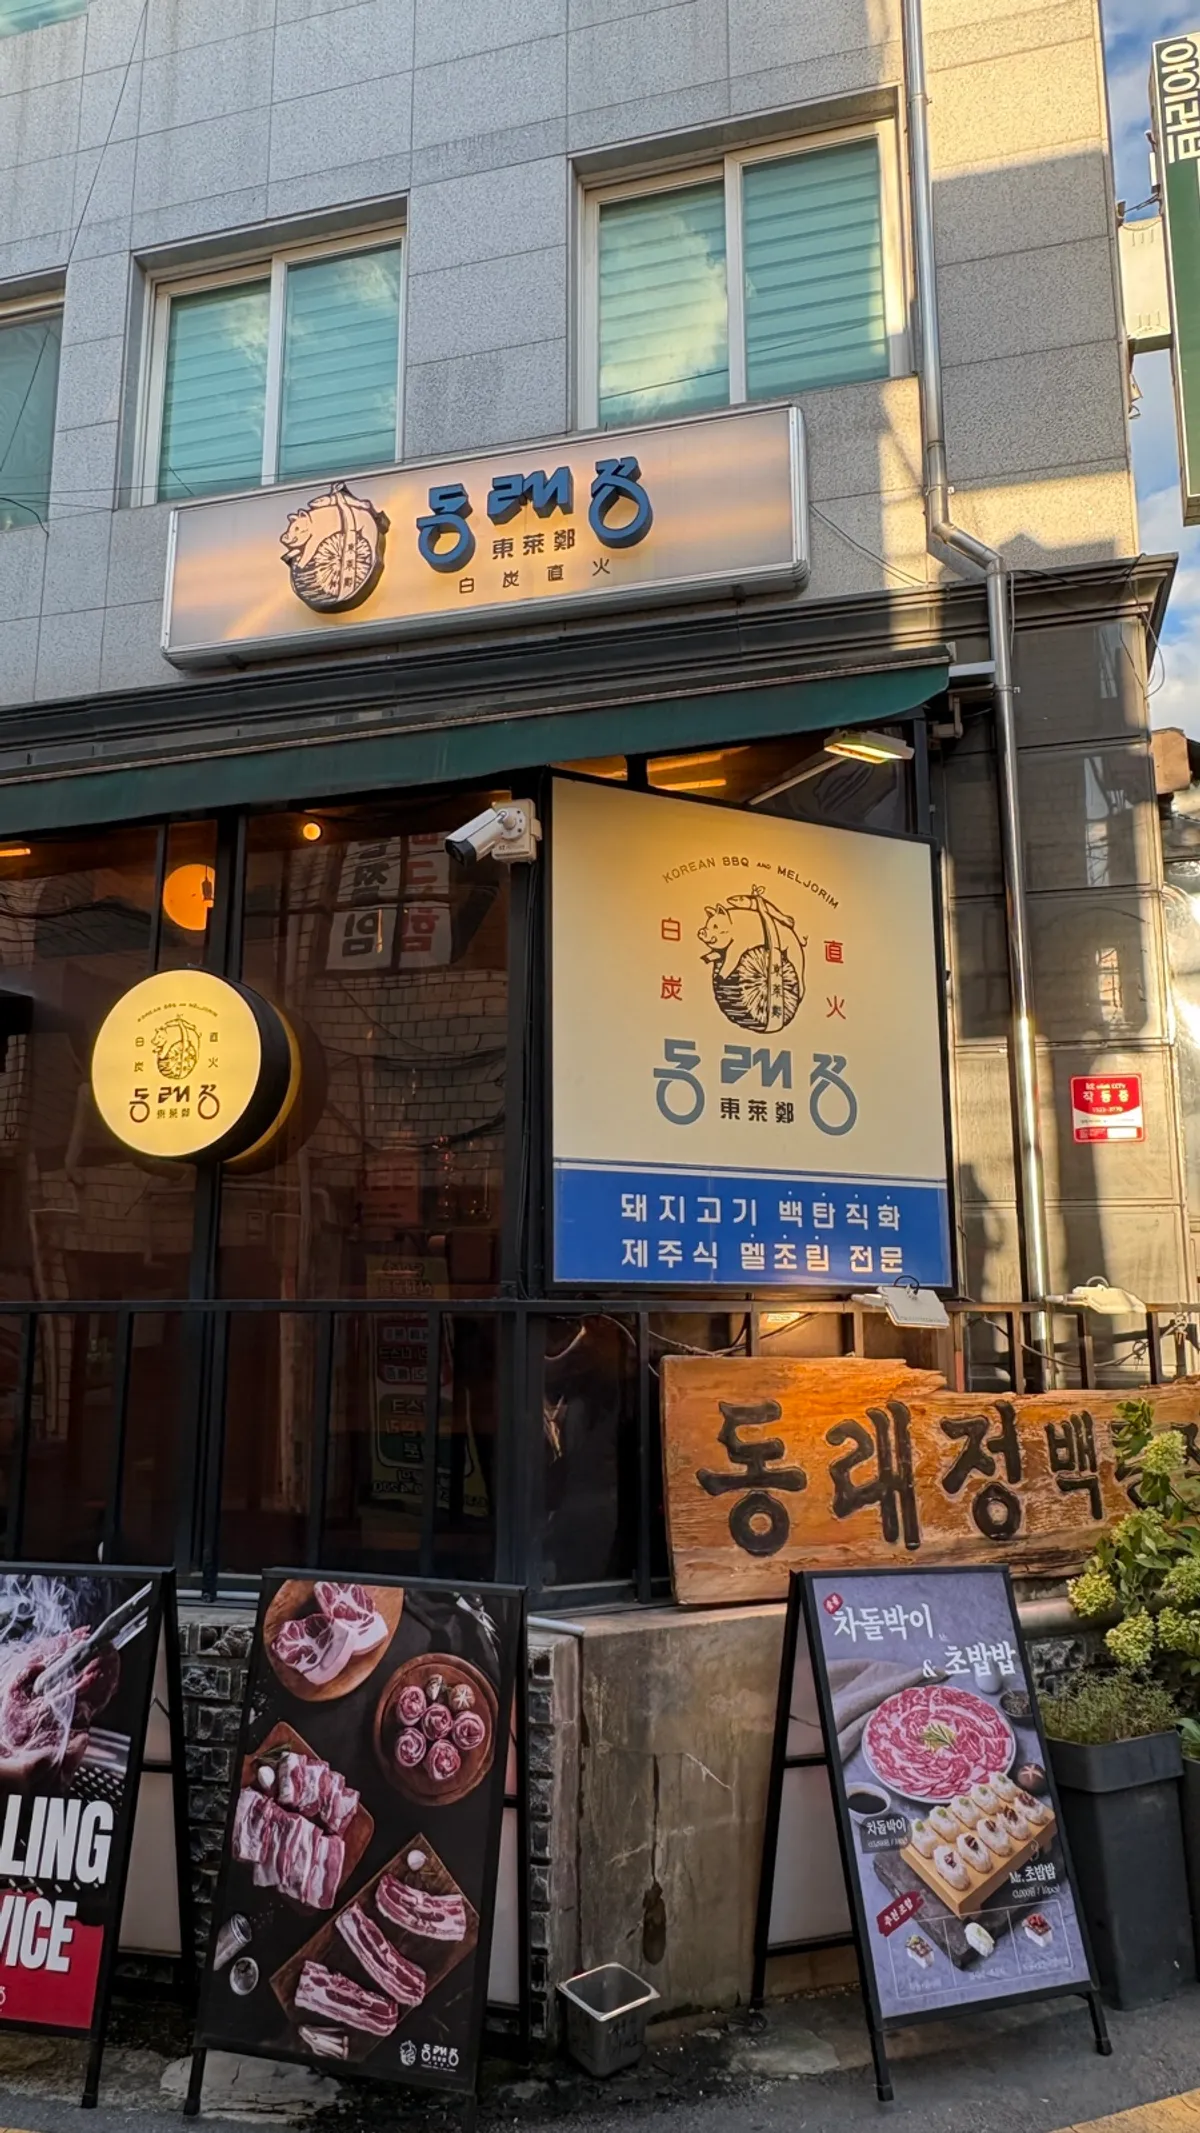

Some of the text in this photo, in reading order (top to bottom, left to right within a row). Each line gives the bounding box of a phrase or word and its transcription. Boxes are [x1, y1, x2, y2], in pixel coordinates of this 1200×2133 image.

[492, 529, 575, 560] 東萊鄭
[662, 857, 716, 883] KOREAN
[722, 856, 750, 868] BBQ
[777, 866, 839, 909] MELJORIM
[720, 1097, 794, 1123] 東萊鄭
[621, 1193, 900, 1231] 돼지고기 백탄직화
[621, 1238, 904, 1273] 제주식 멜조림 전문
[832, 1603, 934, 1643] 차돌박이
[922, 1640, 1016, 1678] & 초밥밥
[866, 1817, 907, 1836] 차돌박이
